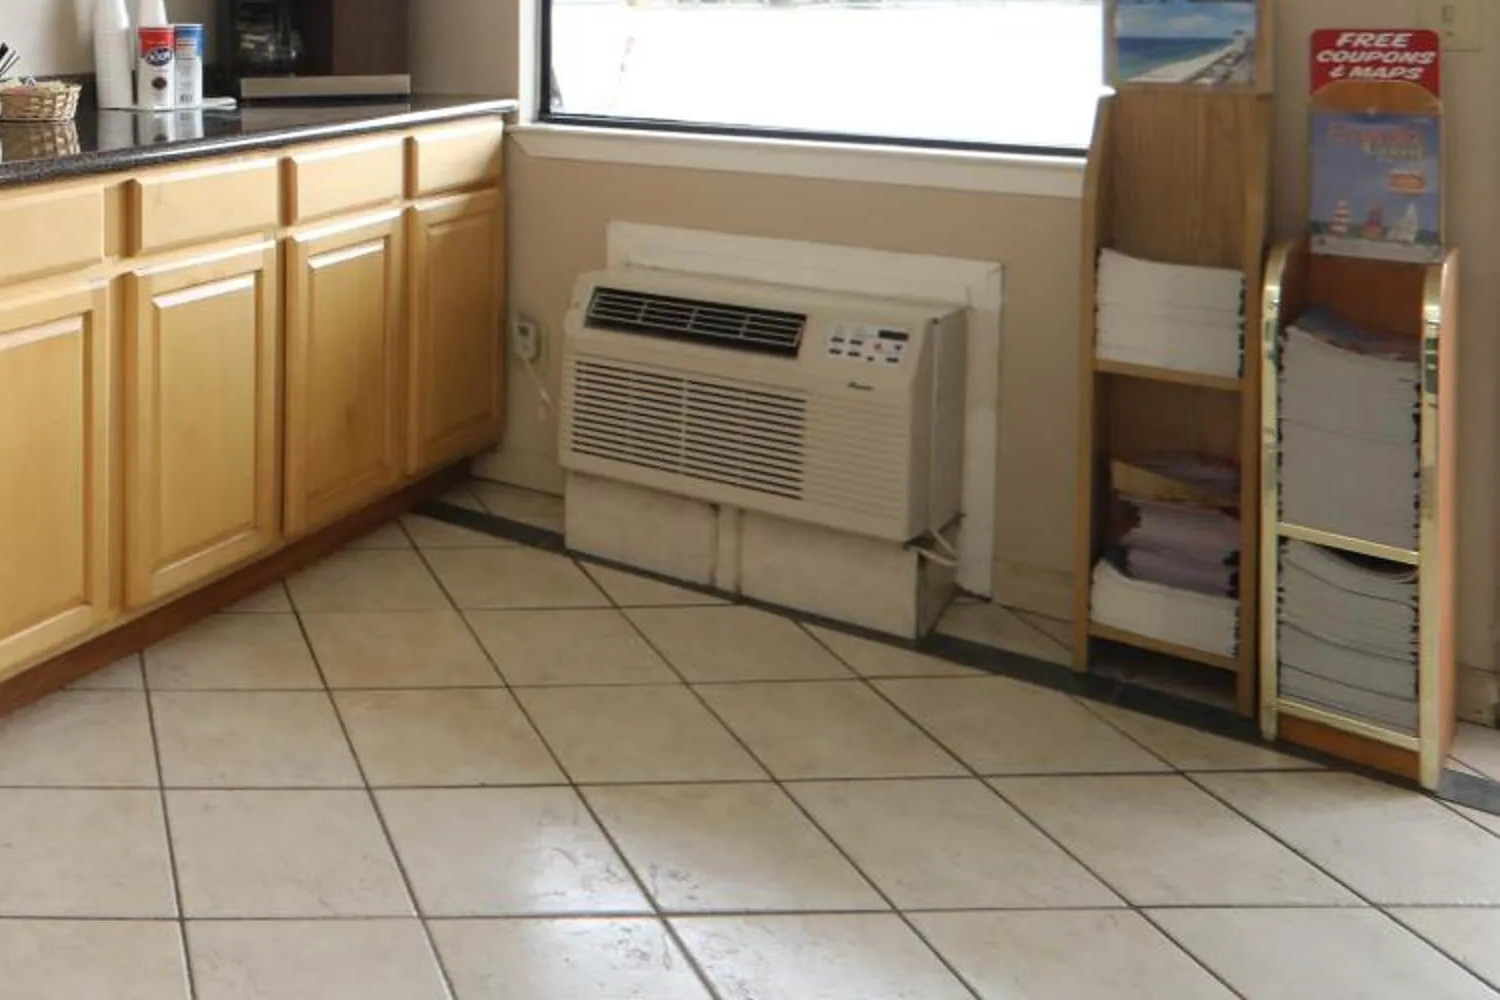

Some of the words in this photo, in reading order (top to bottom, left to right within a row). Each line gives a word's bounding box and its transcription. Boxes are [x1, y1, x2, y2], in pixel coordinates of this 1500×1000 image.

[1335, 32, 1413, 48] FREE
[1316, 49, 1437, 66] COUPONS
[1348, 65, 1425, 81] MAPS
